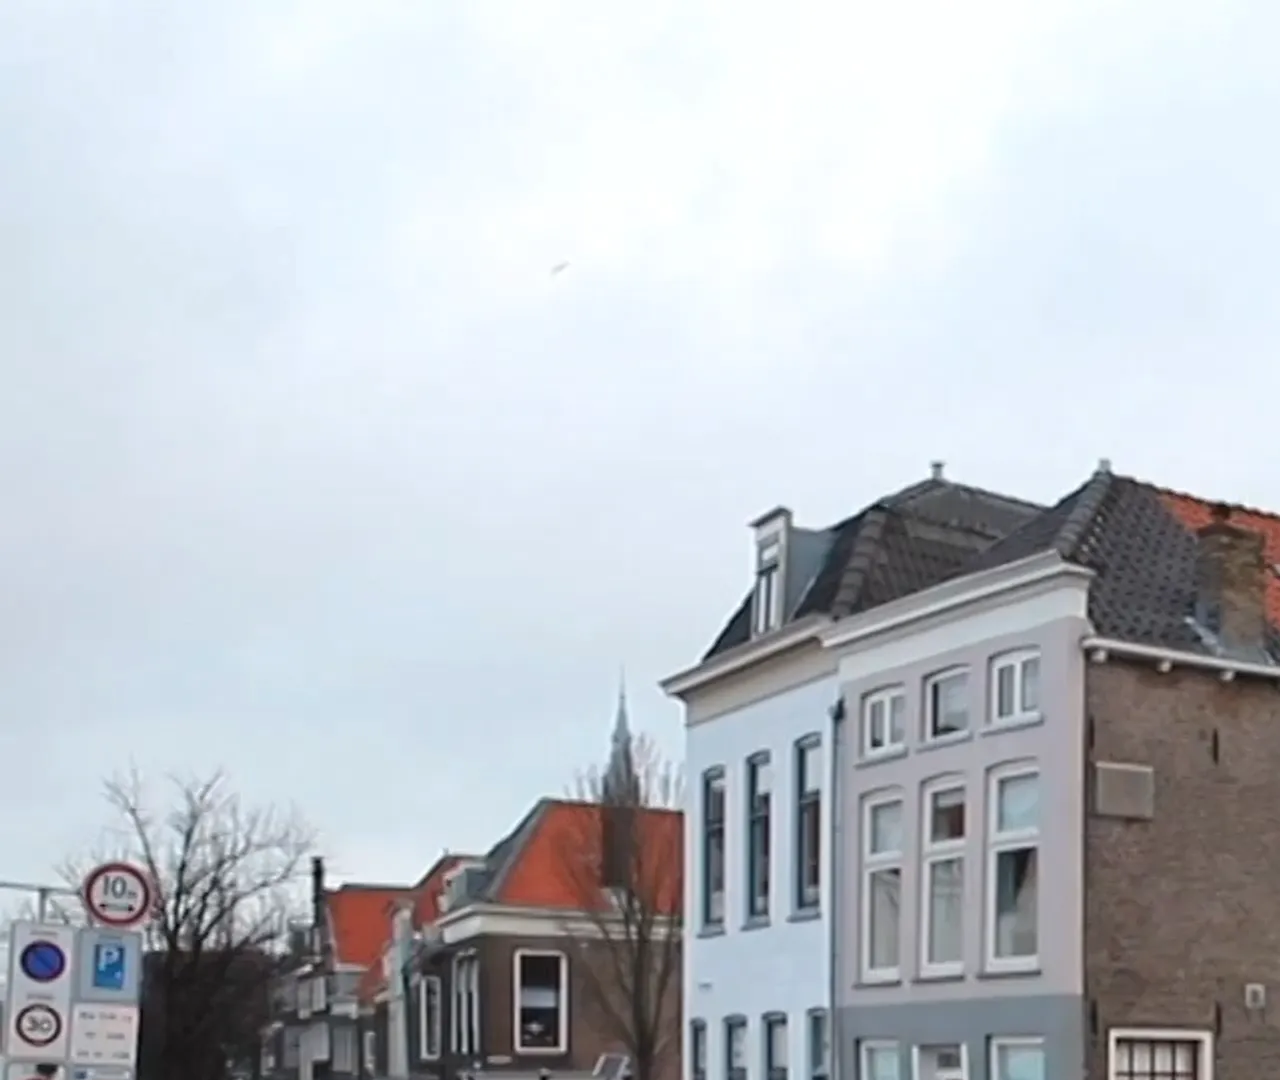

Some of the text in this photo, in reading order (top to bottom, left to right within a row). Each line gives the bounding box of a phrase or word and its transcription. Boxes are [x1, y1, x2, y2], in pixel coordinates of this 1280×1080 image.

[103, 875, 127, 899] 10
[99, 943, 120, 972] P
[27, 1016, 52, 1033] 30
